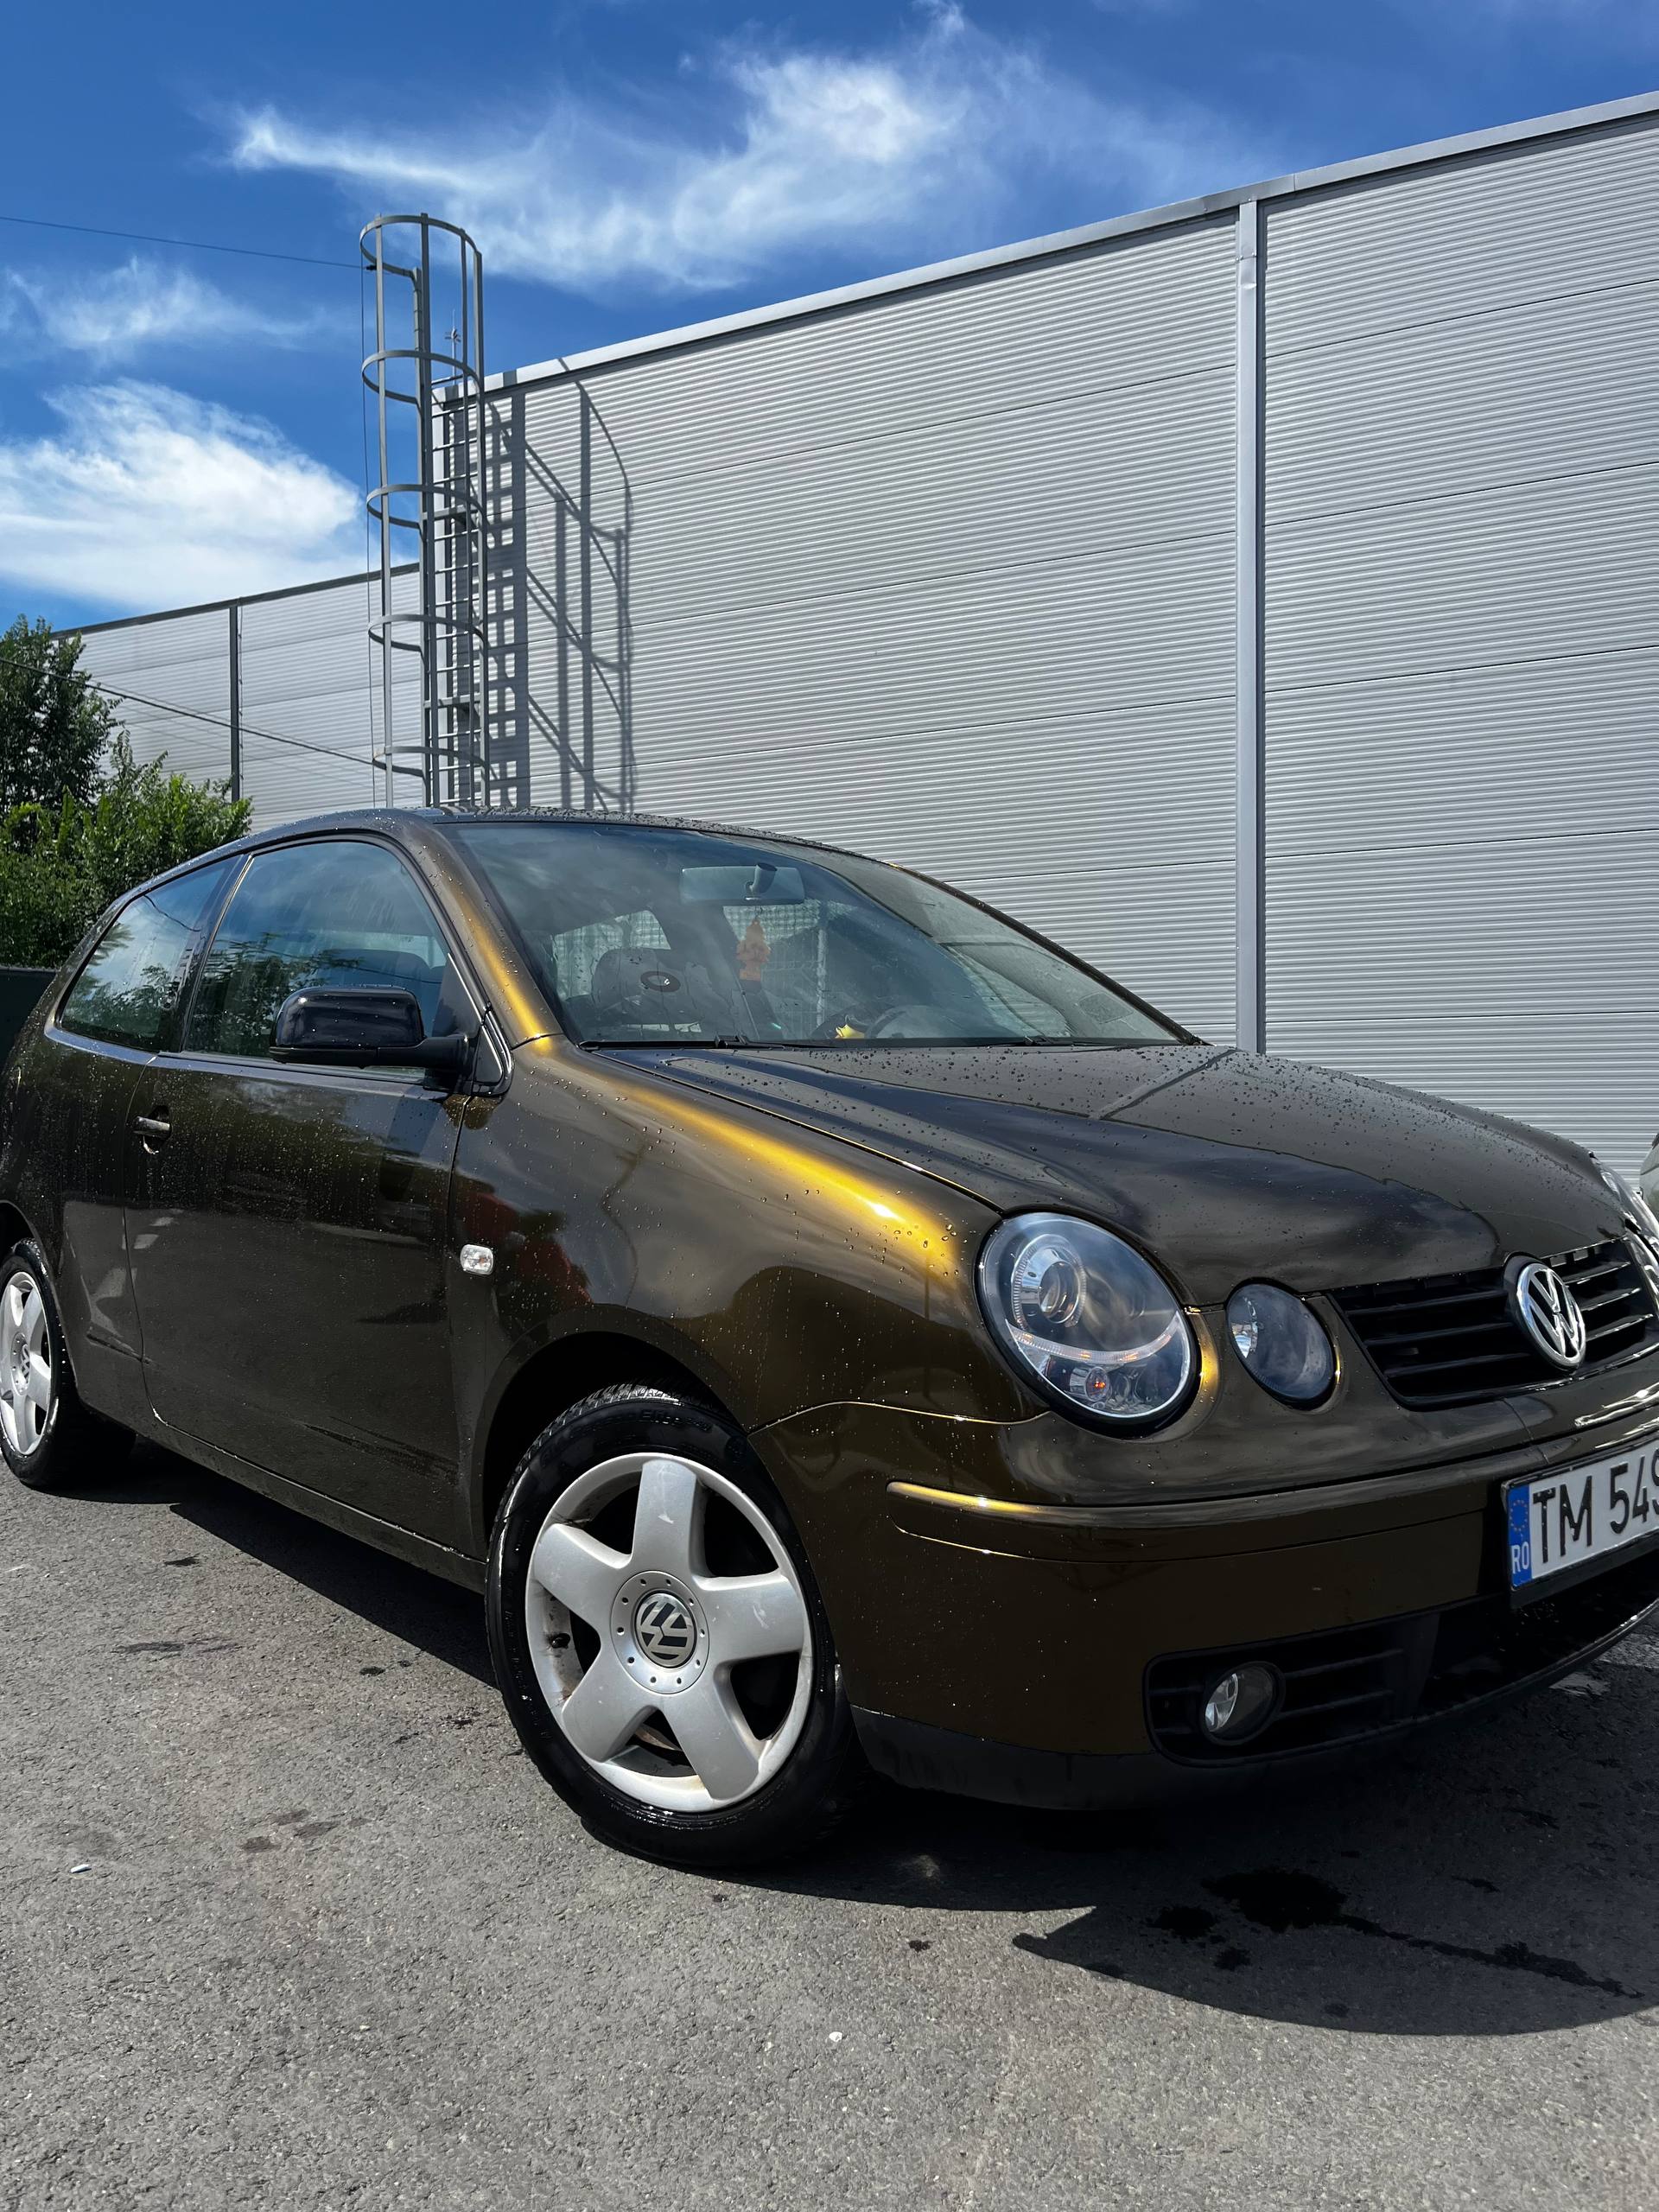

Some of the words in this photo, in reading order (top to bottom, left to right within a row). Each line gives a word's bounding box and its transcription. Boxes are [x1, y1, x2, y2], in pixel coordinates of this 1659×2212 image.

[1522, 1266, 1583, 1362] VW
[1512, 1541, 1529, 1574] RO
[1533, 1475, 1593, 1564] TM
